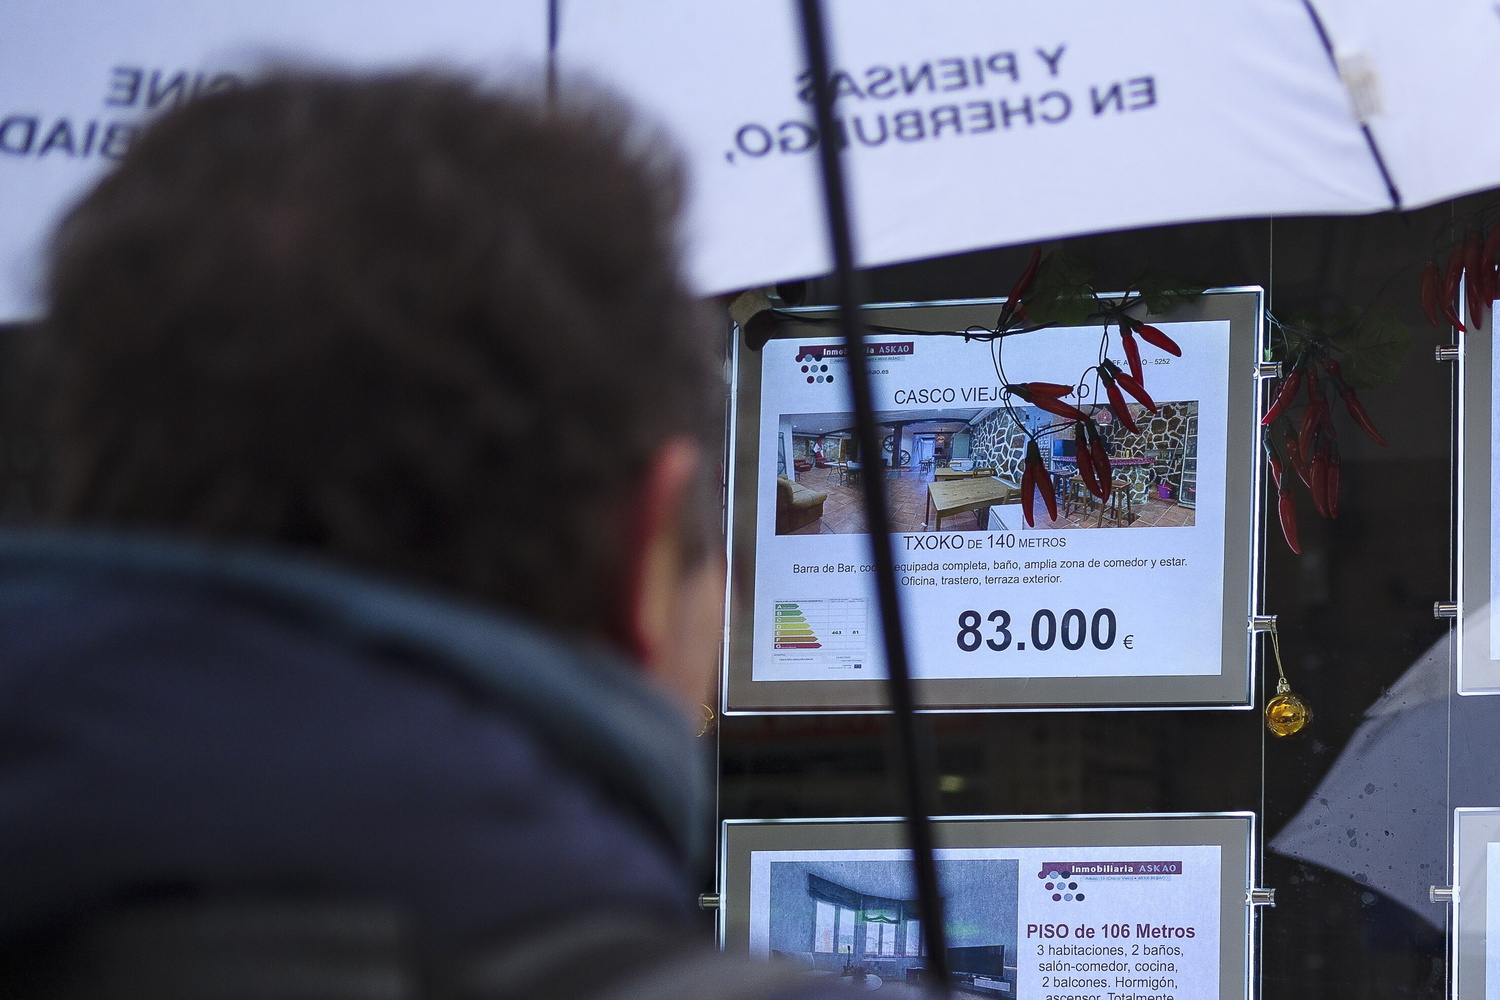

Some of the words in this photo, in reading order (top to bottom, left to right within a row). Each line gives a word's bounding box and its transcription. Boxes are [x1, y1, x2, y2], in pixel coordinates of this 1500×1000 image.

[878, 344, 910, 354] ASKAO
[893, 387, 956, 405] CASCO
[960, 385, 1012, 403] VIEJO
[902, 533, 964, 551] TXOKO
[967, 538, 983, 549] DE
[986, 533, 1016, 549] 140
[1018, 536, 1067, 548] METROS
[956, 607, 1117, 652] 83.000
[1122, 634, 1134, 650] €
[1071, 864, 1134, 873] Inmobiliaria
[1138, 864, 1176, 872] ASKAO
[1026, 923, 1069, 939] PISO
[1074, 923, 1095, 939] de
[1100, 923, 1130, 939] 106
[1135, 923, 1196, 939] Metros
[1036, 943, 1045, 956] 3
[1048, 943, 1128, 957] habitaciones,
[1130, 943, 1139, 956] 2
[1142, 943, 1184, 957] baños,
[1038, 959, 1131, 974] salón-comedor,
[1134, 959, 1178, 974] cocina,
